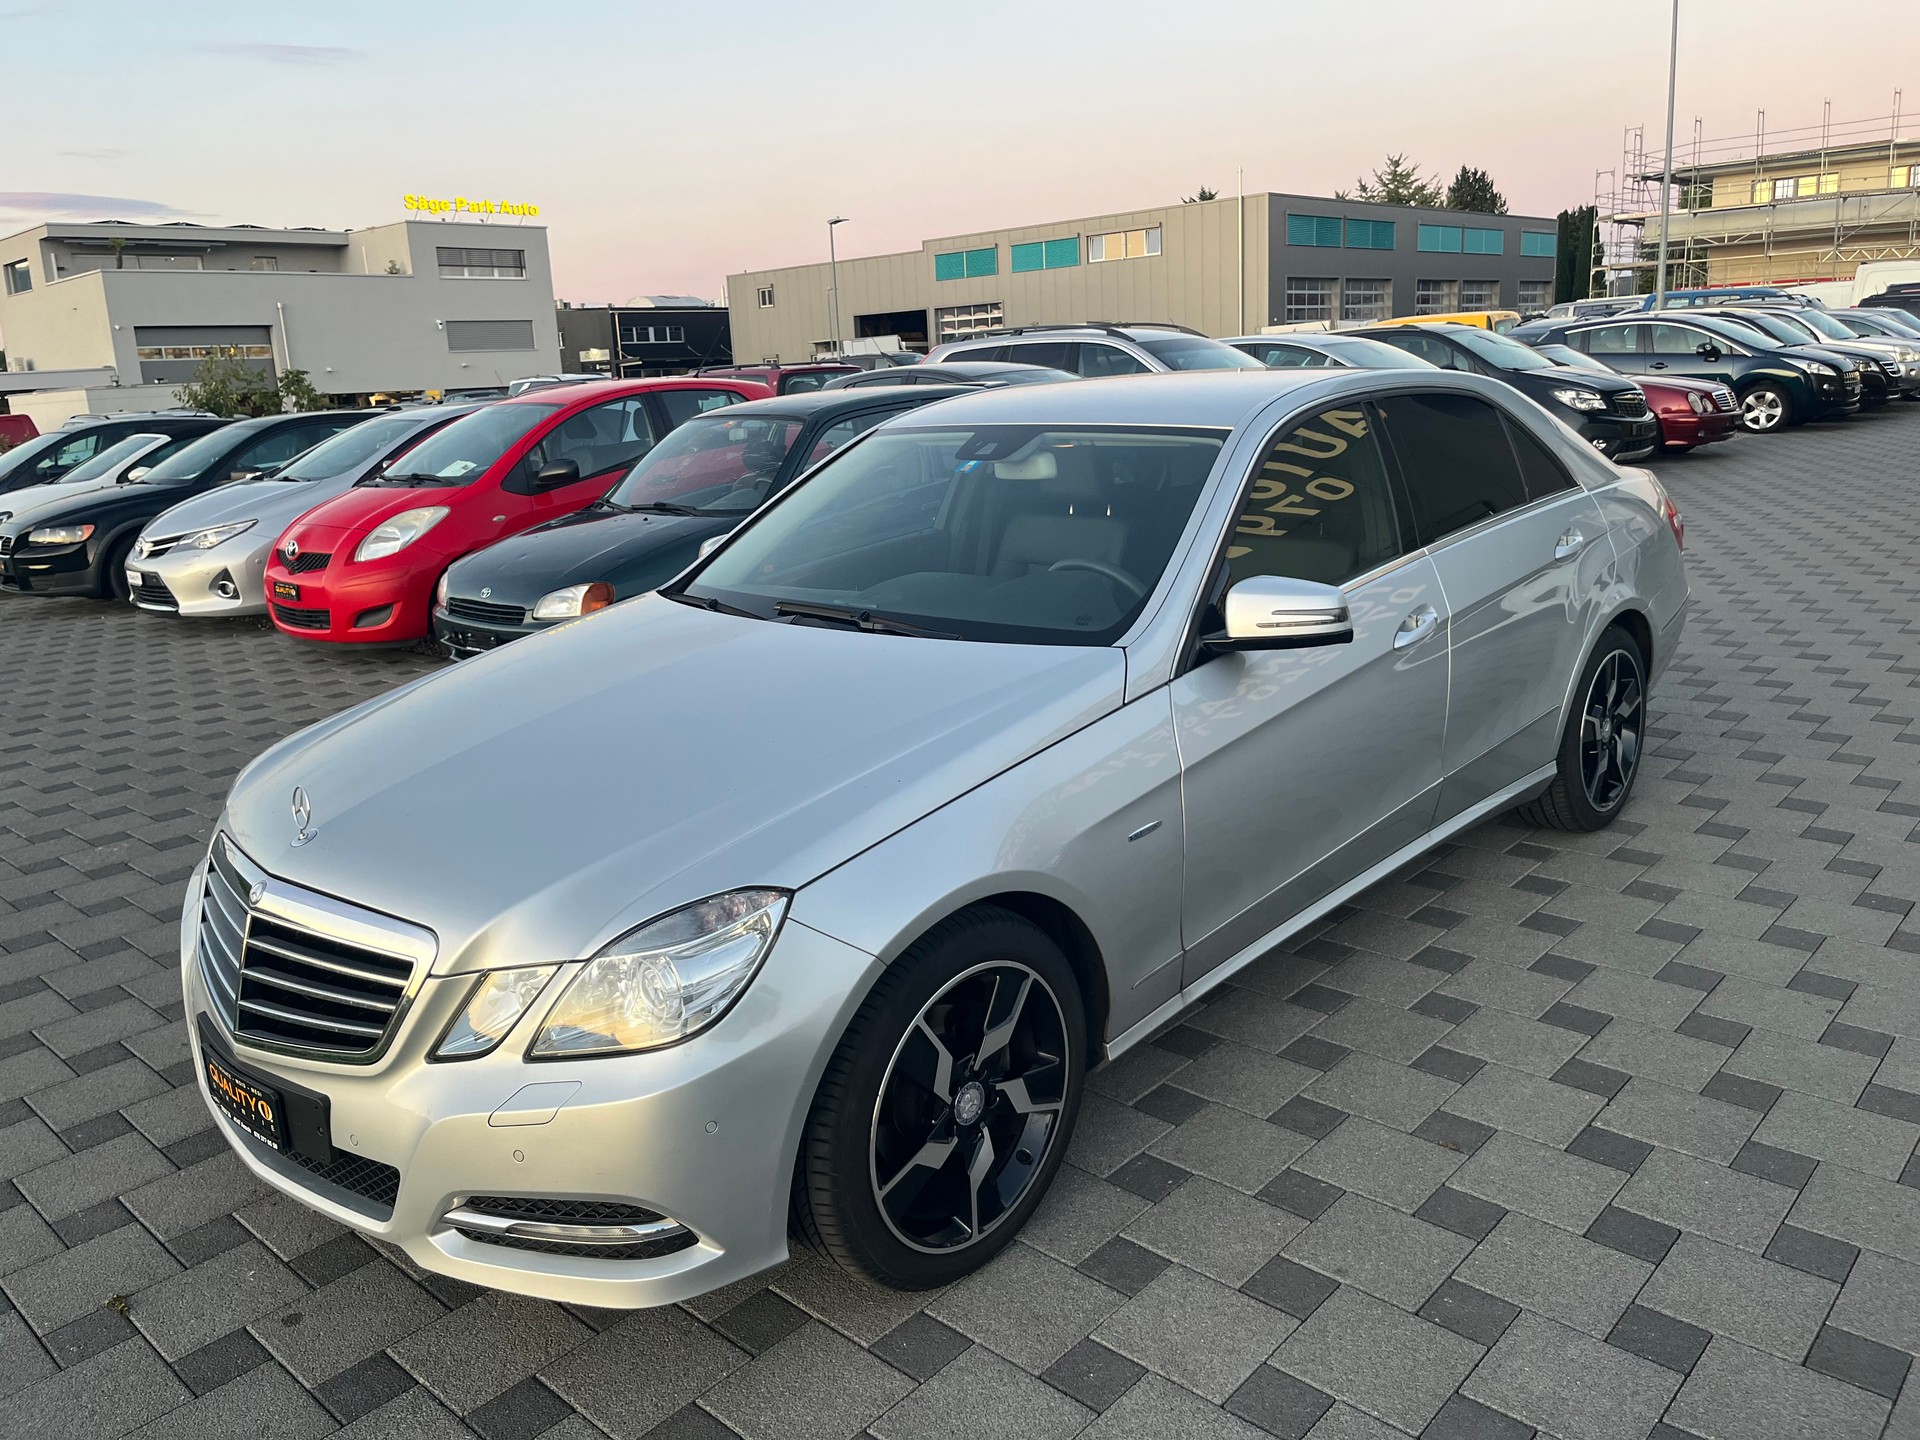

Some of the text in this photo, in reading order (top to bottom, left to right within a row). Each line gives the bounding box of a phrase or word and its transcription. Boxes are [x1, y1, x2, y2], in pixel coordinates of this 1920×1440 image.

[404, 194, 540, 216] Säge Park Auto
[209, 1063, 256, 1112] QUALITY
